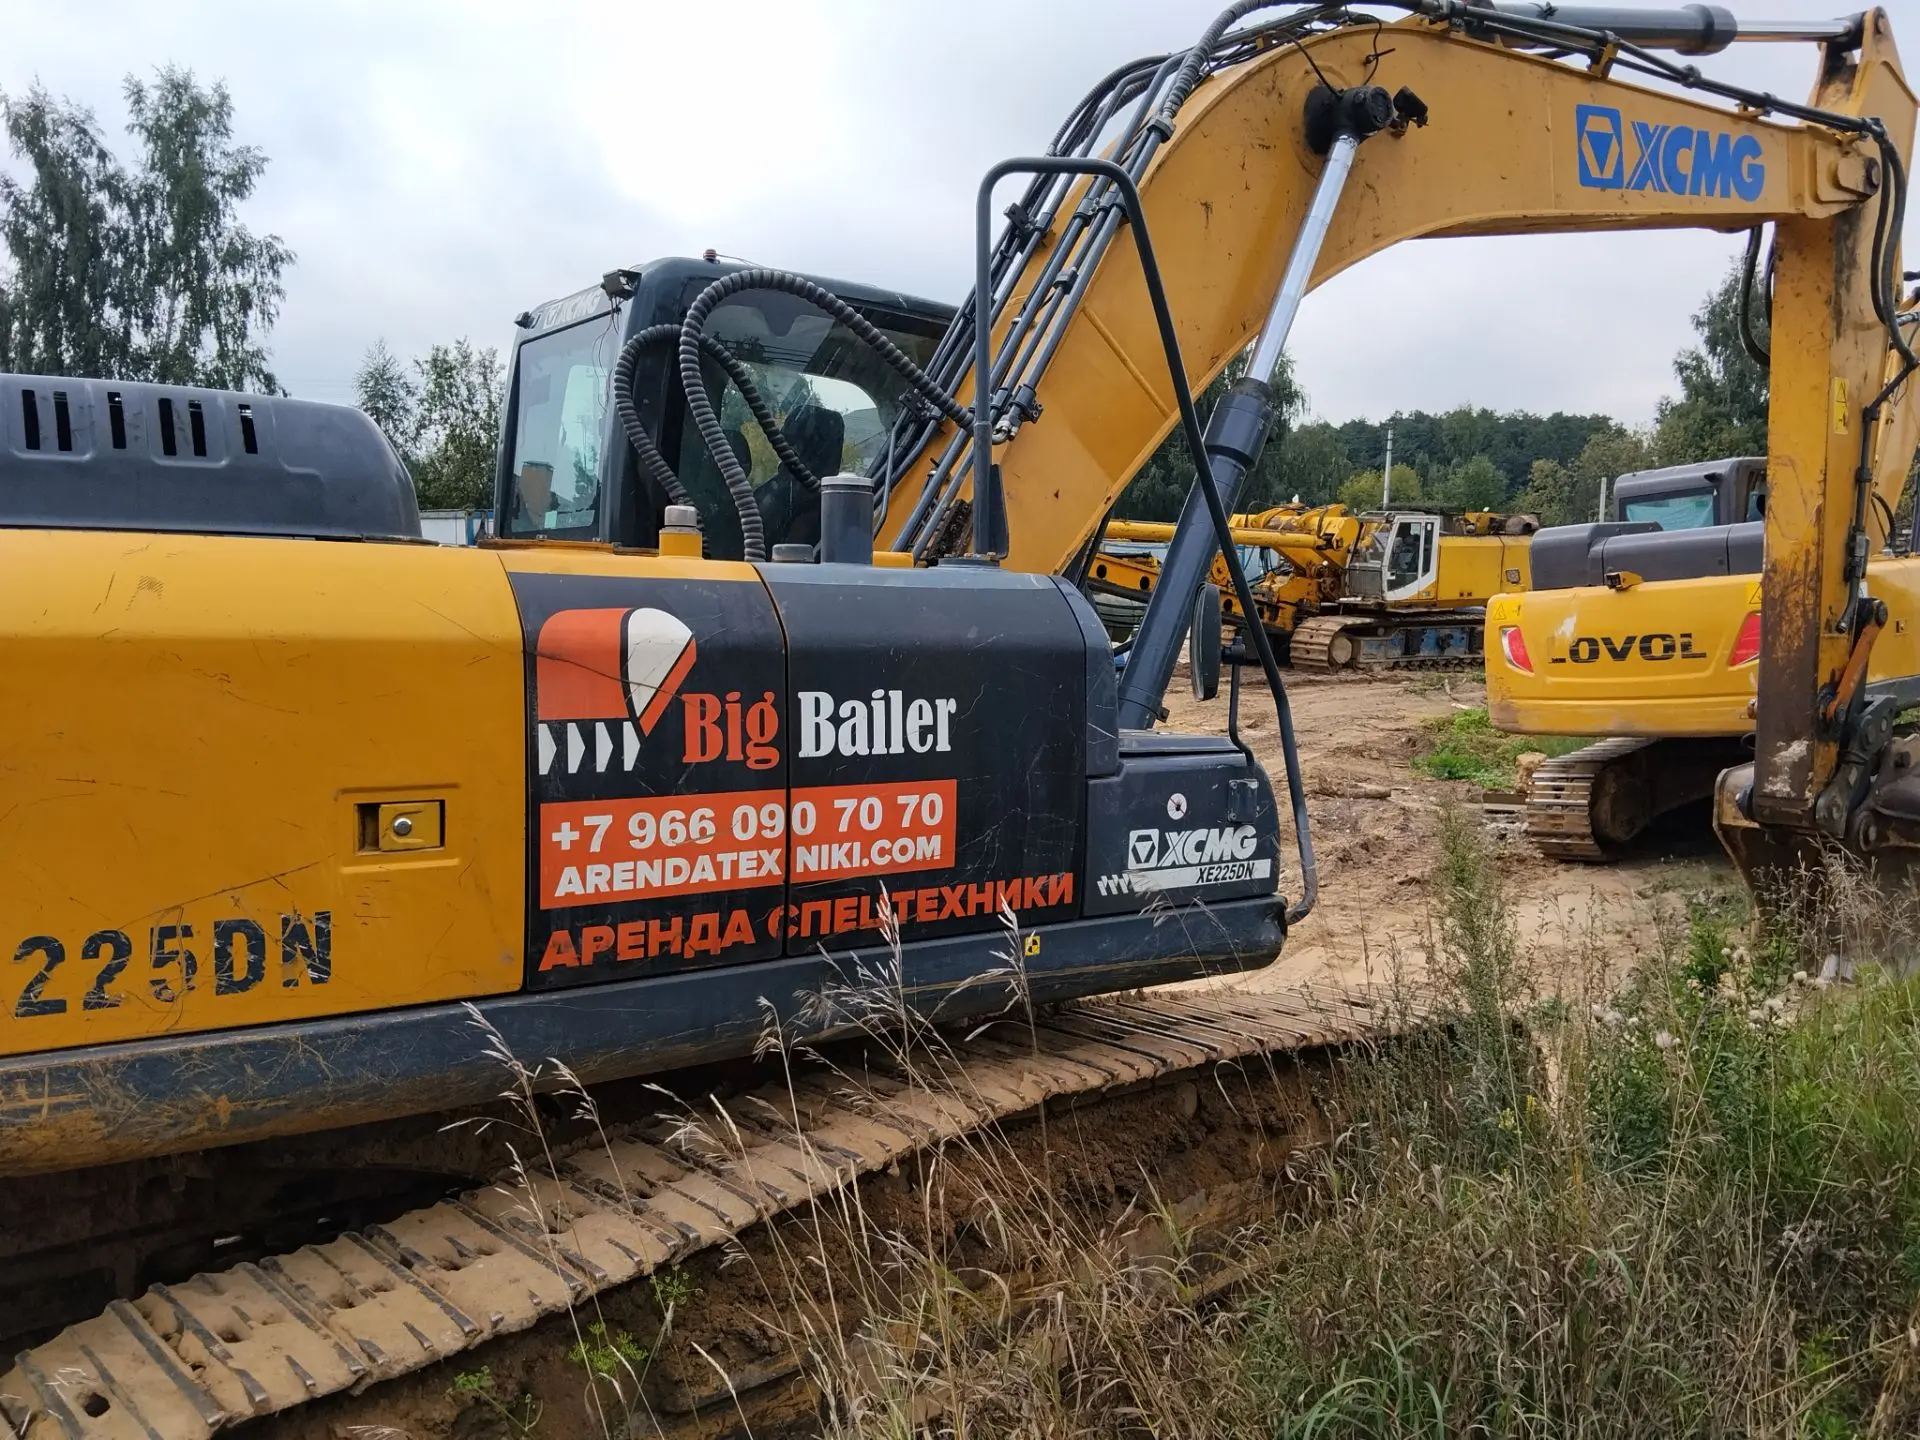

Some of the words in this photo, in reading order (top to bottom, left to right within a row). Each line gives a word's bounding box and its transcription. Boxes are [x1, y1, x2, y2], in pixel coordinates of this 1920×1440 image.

[1625, 120, 1765, 202] XCMG
[682, 691, 780, 770] Big
[797, 689, 957, 758] Bailer
[551, 815, 613, 853] +7
[628, 808, 716, 849] 966
[732, 802, 816, 841] 090
[834, 797, 883, 832] 70
[897, 793, 943, 827] 70
[1158, 825, 1257, 867] XCMG
[1196, 861, 1255, 884] XE225DN
[538, 909, 756, 971] АРЕНДА
[767, 873, 1073, 939] СПЕЦТЕХНИКИ
[13, 910, 332, 1018] 225DN
